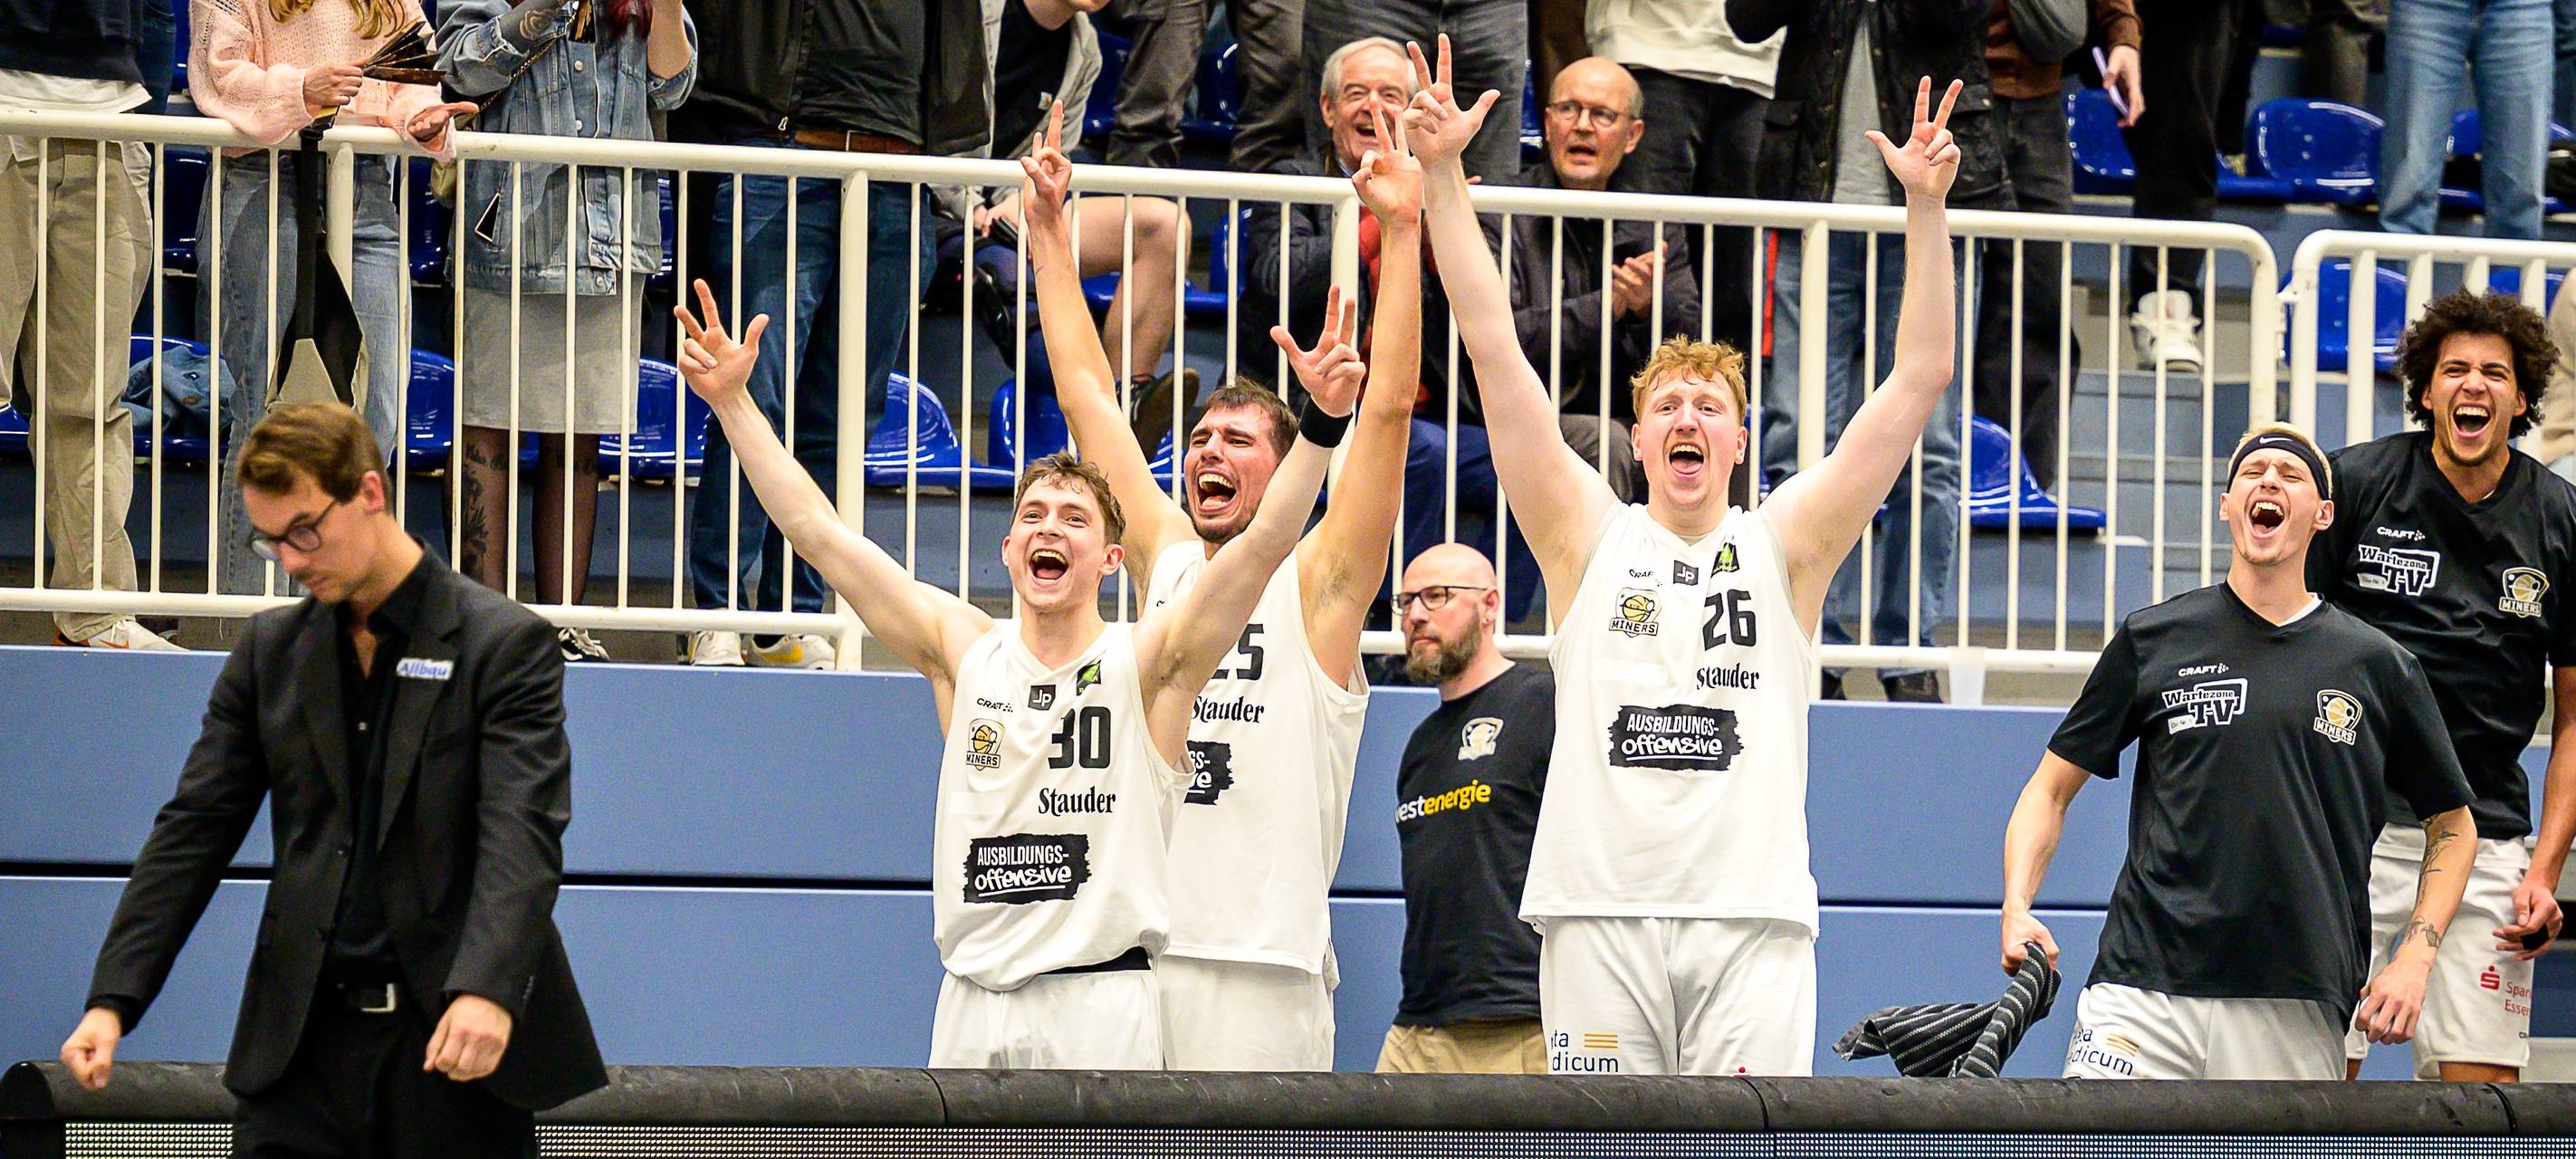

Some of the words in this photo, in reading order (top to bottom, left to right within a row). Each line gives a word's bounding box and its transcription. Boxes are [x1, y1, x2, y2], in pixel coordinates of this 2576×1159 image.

[2377, 527, 2415, 540] CRAFT
[2359, 545, 2427, 569] Wartezone
[1629, 570, 1655, 579] CRAF
[1611, 618, 1656, 633] MINERS
[1702, 589, 1757, 651] 26
[1211, 624, 1264, 680] 5
[2178, 666, 2217, 676] CRAFT
[2163, 689, 2234, 707] Wartezone
[1626, 713, 1719, 736] AUSBILDUNGS-
[2317, 720, 2353, 742] MINERS
[1048, 706, 1111, 769] 30
[1621, 733, 1723, 755] offensive
[966, 753, 998, 766] MINERS
[1038, 787, 1116, 816] Stauder
[977, 845, 1069, 866] AUSBILDUNGS-
[974, 864, 1072, 891] offensive
